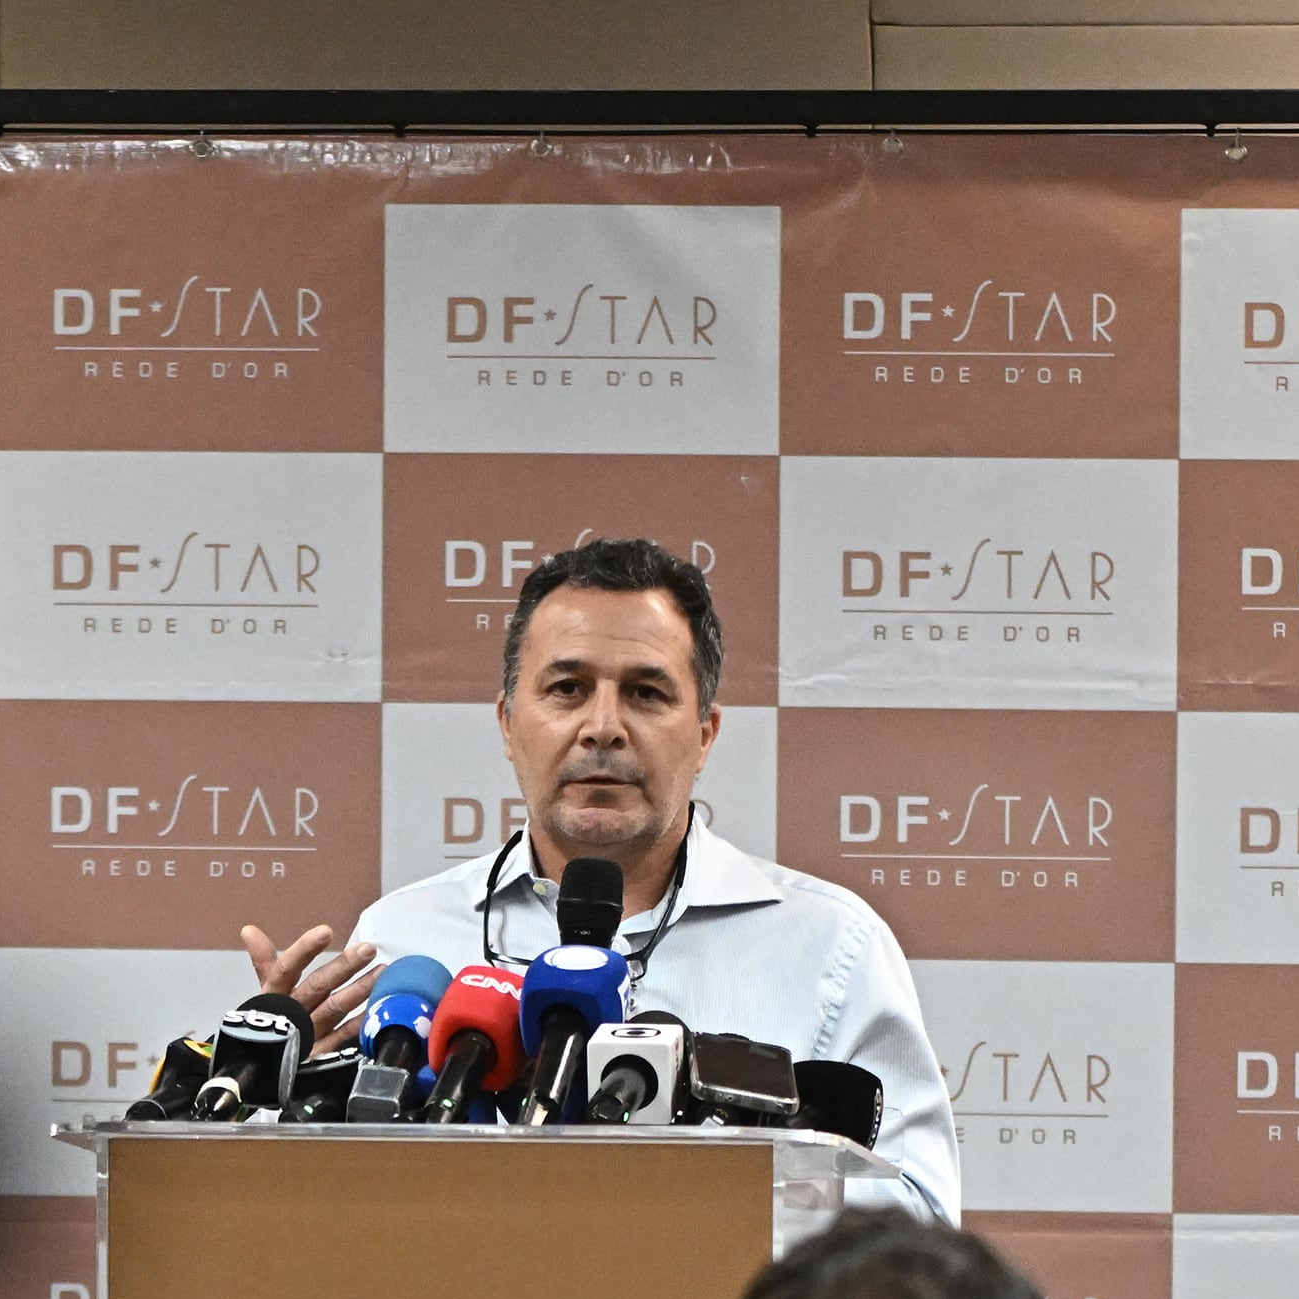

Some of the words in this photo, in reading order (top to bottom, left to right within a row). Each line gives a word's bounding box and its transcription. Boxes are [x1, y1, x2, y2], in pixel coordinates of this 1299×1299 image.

[54, 289, 141, 335] DF
[161, 276, 321, 337] STAR
[447, 297, 535, 343] DF
[555, 284, 717, 346] STAR
[844, 293, 932, 339] DF
[953, 280, 1116, 342] STAR
[85, 362, 178, 377] REDE
[212, 362, 287, 378] D'OR
[478, 370, 572, 386] REDE
[607, 370, 683, 387] D'OR
[875, 366, 970, 383] REDE
[1005, 367, 1081, 383] D'OR
[53, 544, 140, 590] DF
[161, 532, 320, 593] STAR
[445, 541, 534, 588] DF
[843, 551, 931, 597] DF
[951, 538, 1114, 601] STAR
[84, 617, 176, 634] REDE
[211, 618, 286, 634] D'OR
[873, 625, 968, 641] REDE
[1003, 626, 1080, 642] D'OR
[52, 787, 139, 833] DF
[158, 775, 318, 836] STAR
[443, 797, 528, 845] DF
[840, 796, 929, 842] DF
[949, 784, 1112, 846] STAR
[82, 859, 175, 876] REDE
[210, 861, 285, 877] D'OR
[872, 869, 966, 886] REDE
[1001, 871, 1078, 887] D'OR
[460, 974, 523, 1001] CNN
[222, 1009, 292, 1036] sbt
[52, 1041, 138, 1088] DF
[950, 1041, 1110, 1103] STAR
[999, 1127, 1077, 1145] D'OR
